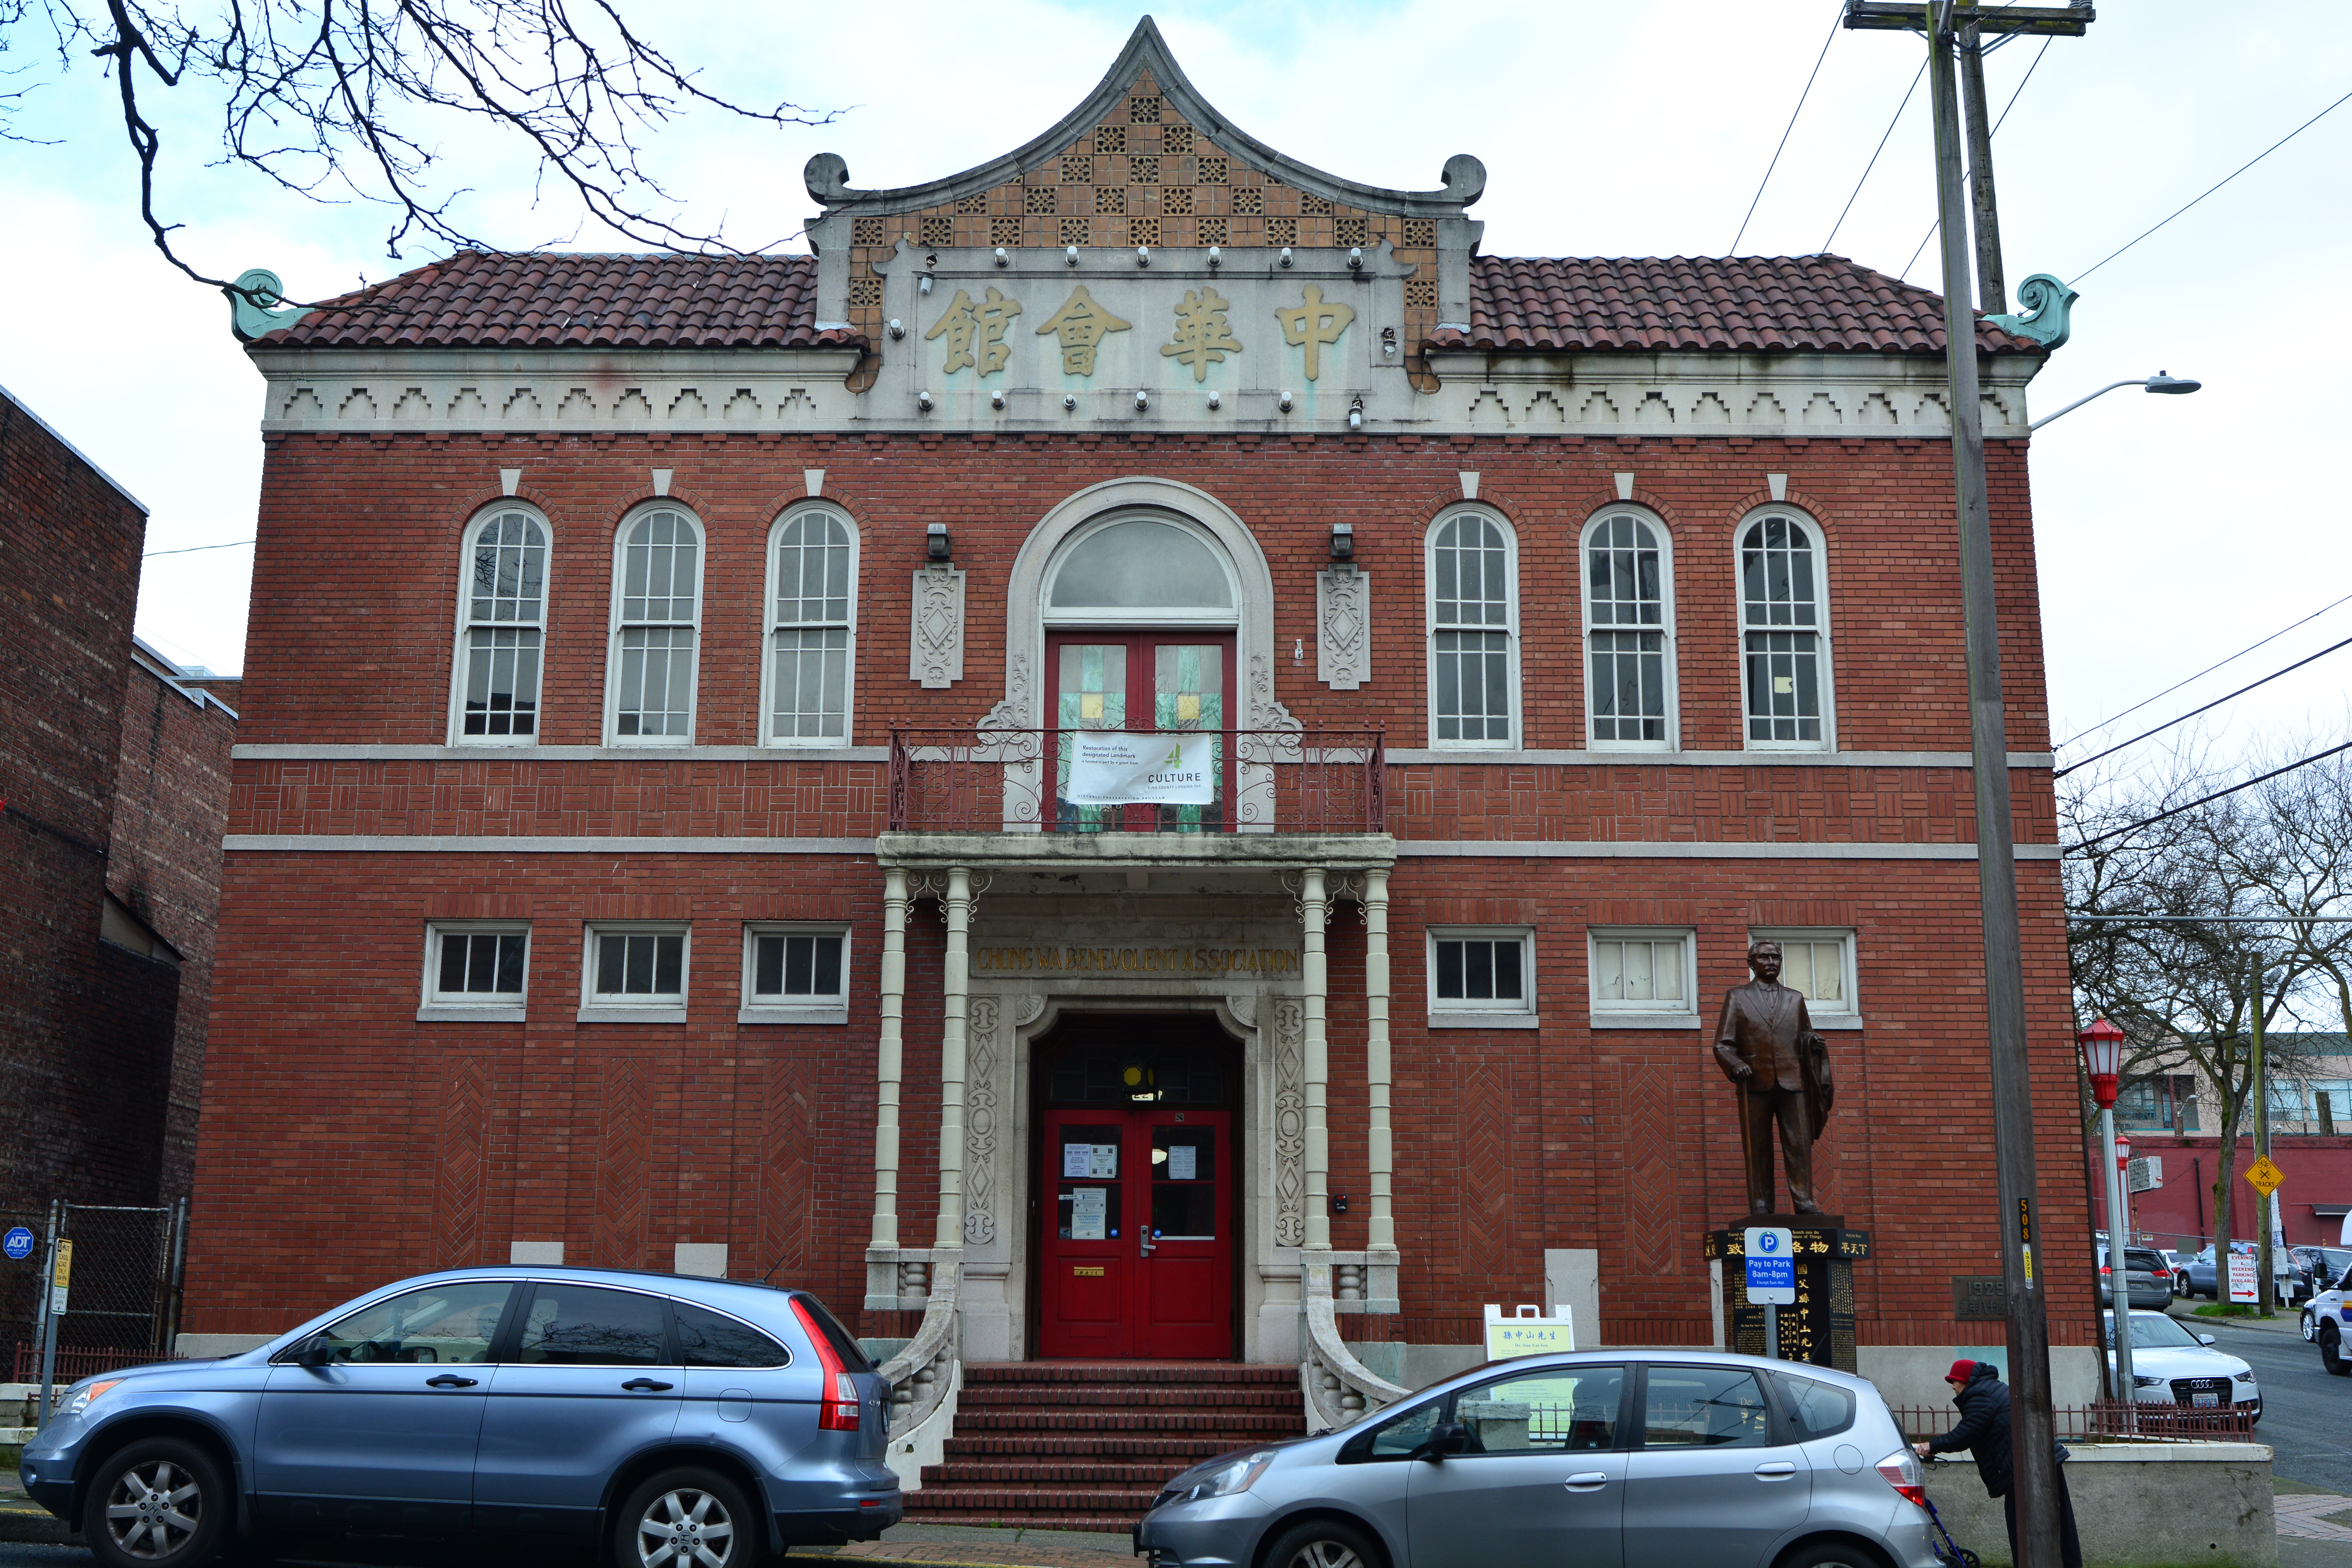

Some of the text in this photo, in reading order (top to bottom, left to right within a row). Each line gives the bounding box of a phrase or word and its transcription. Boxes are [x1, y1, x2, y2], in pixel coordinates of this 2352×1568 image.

[1148, 773, 1201, 783] CULTURE
[977, 947, 1298, 972] CHONG WA BENEVOLENT ASSOCIATION
[2021, 1200, 2029, 1240] 508
[7, 1236, 30, 1248] ADT
[1841, 1242, 1867, 1254] 平天下
[1749, 1260, 1762, 1269] Pay
[1752, 1270, 1788, 1279] 8am-8pm
[1968, 1281, 2004, 1296] 1929
[1503, 1330, 1556, 1340] 孫中山先生
